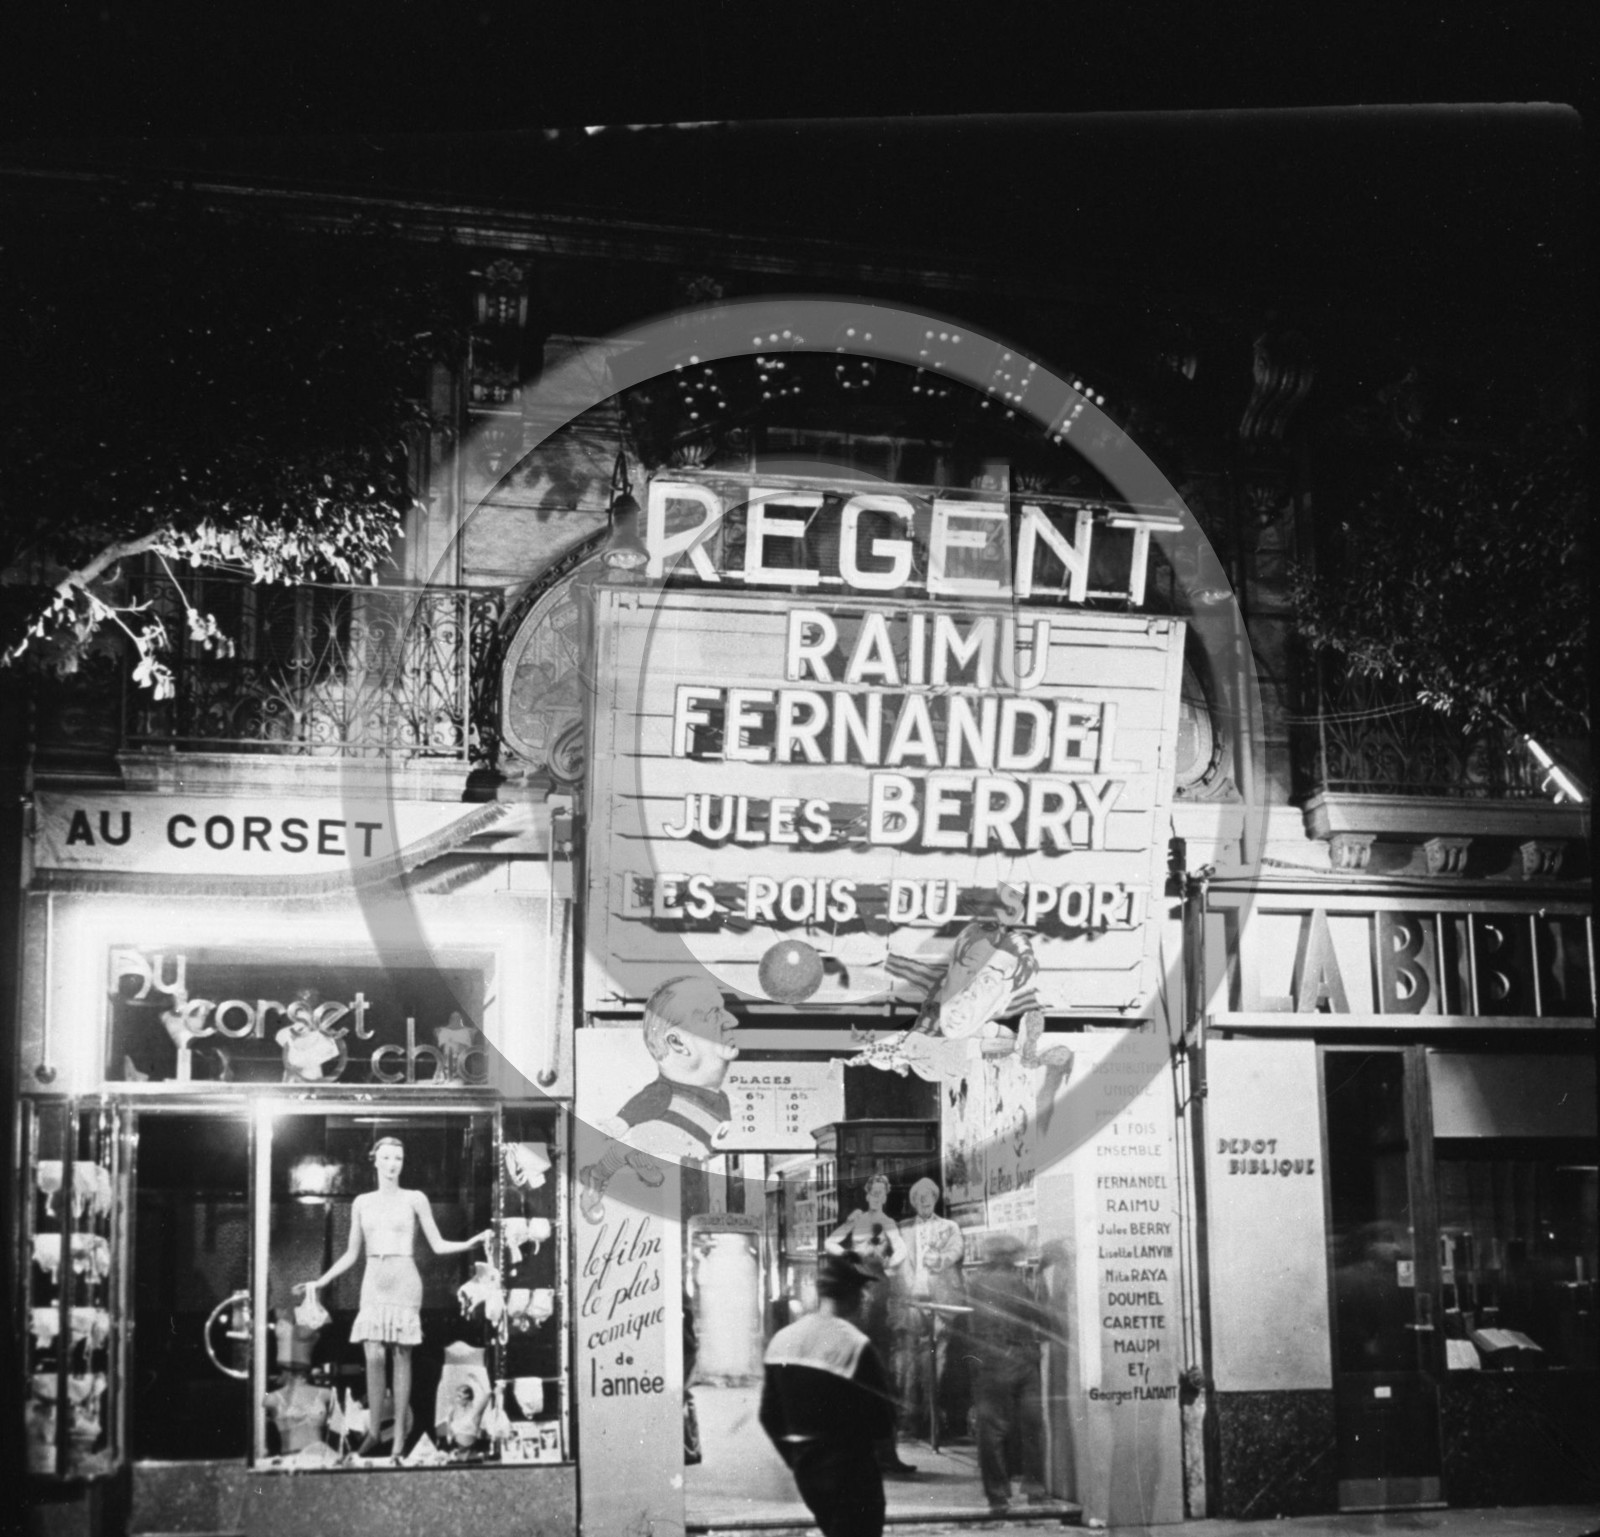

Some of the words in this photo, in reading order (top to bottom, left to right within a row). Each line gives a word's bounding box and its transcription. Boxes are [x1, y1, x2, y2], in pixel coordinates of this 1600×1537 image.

[645, 483, 1184, 606] REGENT
[786, 608, 1050, 690] RAIMU
[673, 685, 1142, 773] FERNANDEL
[664, 794, 832, 844] JULES
[870, 773, 1126, 852] BERRY
[66, 810, 131, 846] AU
[167, 814, 384, 858] CORSET
[621, 873, 715, 920] LES
[746, 879, 857, 923] ROIS
[888, 880, 957, 924] DU
[999, 882, 1149, 928] SPORT
[1241, 907, 1351, 1015] LA
[183, 991, 375, 1039] corset
[729, 1076, 792, 1085] PLACES
[786, 1103, 799, 1111] 10
[1128, 1123, 1156, 1136] FOIS
[1097, 1145, 1163, 1157] ENSEMBLE
[1217, 1138, 1278, 1155] DEPOT
[1229, 1159, 1316, 1177] BIBLIQUE
[1097, 1176, 1168, 1189] FERNANDEL
[1106, 1199, 1160, 1212] RAIMU
[1098, 1223, 1128, 1235] Jules
[1130, 1222, 1172, 1235] BERRY
[597, 1216, 662, 1290] film
[1105, 1268, 1130, 1282] Nita
[1131, 1267, 1168, 1282] RAYA
[607, 1261, 660, 1320] plus
[1108, 1291, 1164, 1306] DOUMEL
[588, 1306, 665, 1349] comique
[1102, 1315, 1166, 1329] CARETTE
[1113, 1339, 1160, 1353] MAUPI
[615, 1352, 634, 1366] de
[1089, 1387, 1132, 1406] Georges
[1133, 1385, 1177, 1399] FLAMANT
